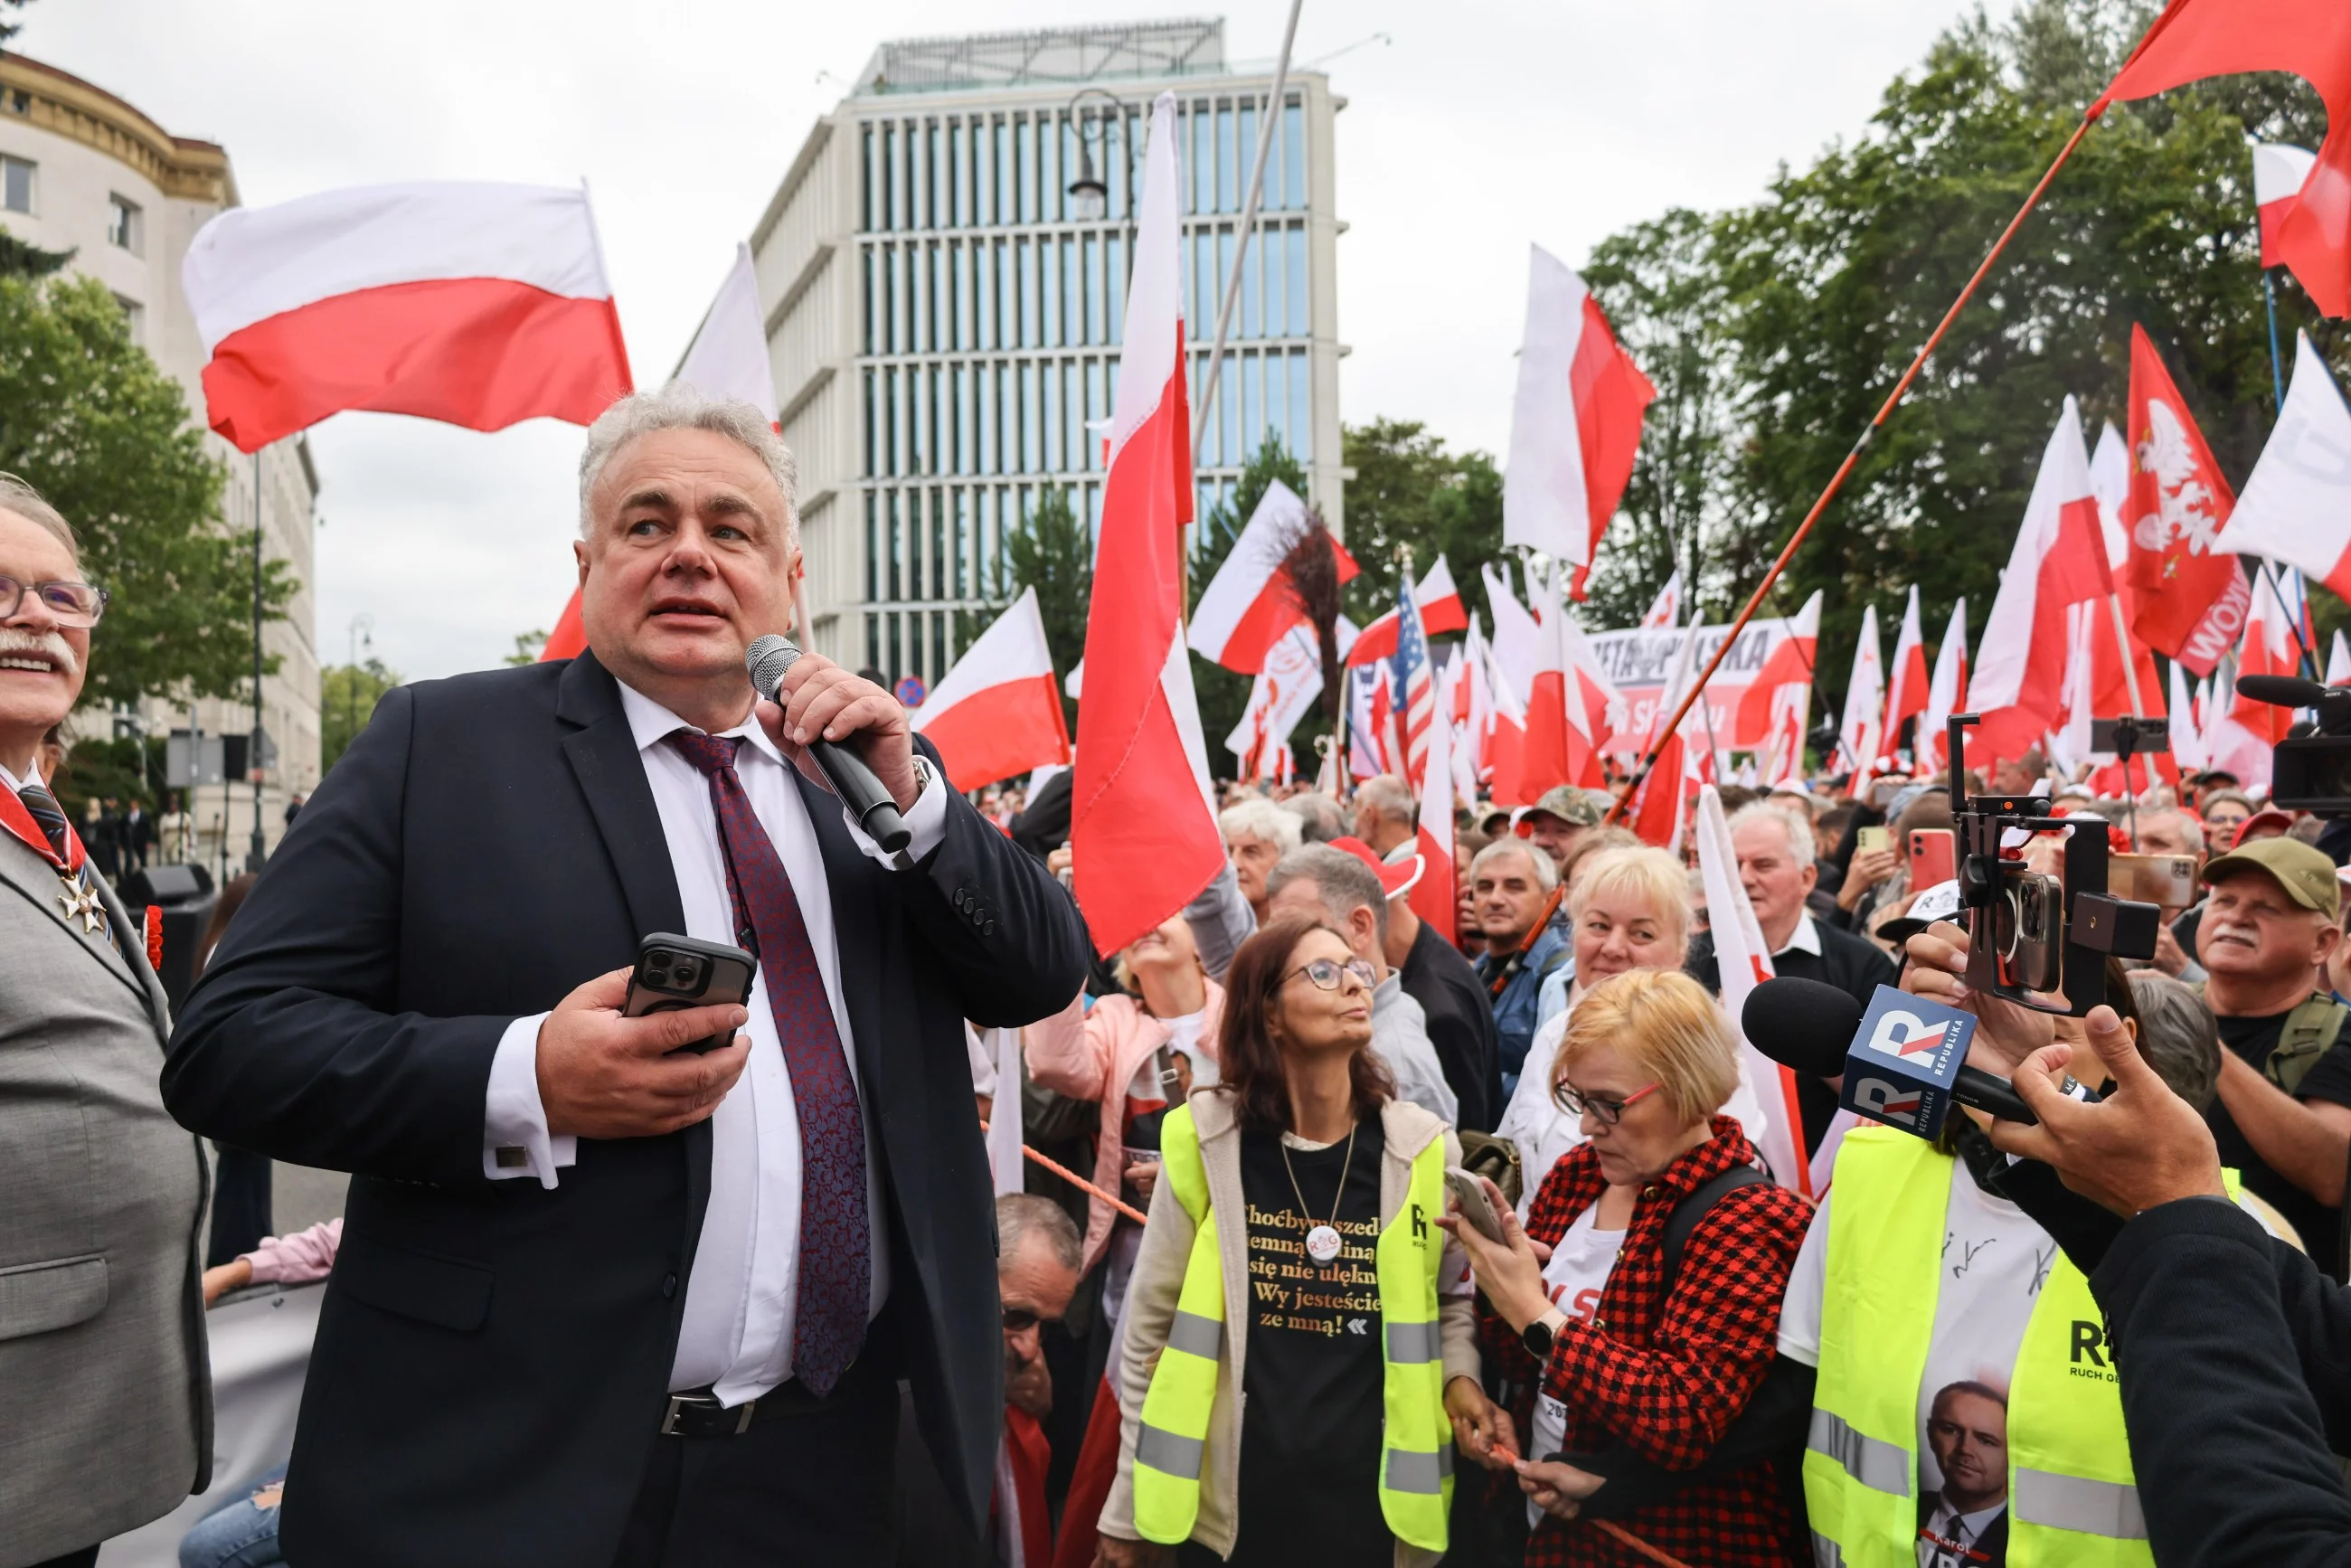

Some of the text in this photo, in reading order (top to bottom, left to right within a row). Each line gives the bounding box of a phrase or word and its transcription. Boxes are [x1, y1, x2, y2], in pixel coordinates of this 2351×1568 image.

[1593, 637, 1638, 677] ETA
[1934, 1020, 1964, 1076] REPUBLIKA
[1918, 1091, 1935, 1133] REPUBLIKA
[1245, 1204, 1381, 1236] hoćbym szed
[1248, 1231, 1305, 1258] emną
[1249, 1256, 1377, 1287] się nie ulękn
[1253, 1281, 1381, 1311] Wy jesteście
[1260, 1312, 1283, 1327] ze
[1288, 1315, 1343, 1337] mną!
[2070, 1367, 2102, 1380] RUCH
[1935, 1530, 1970, 1554] Karol
